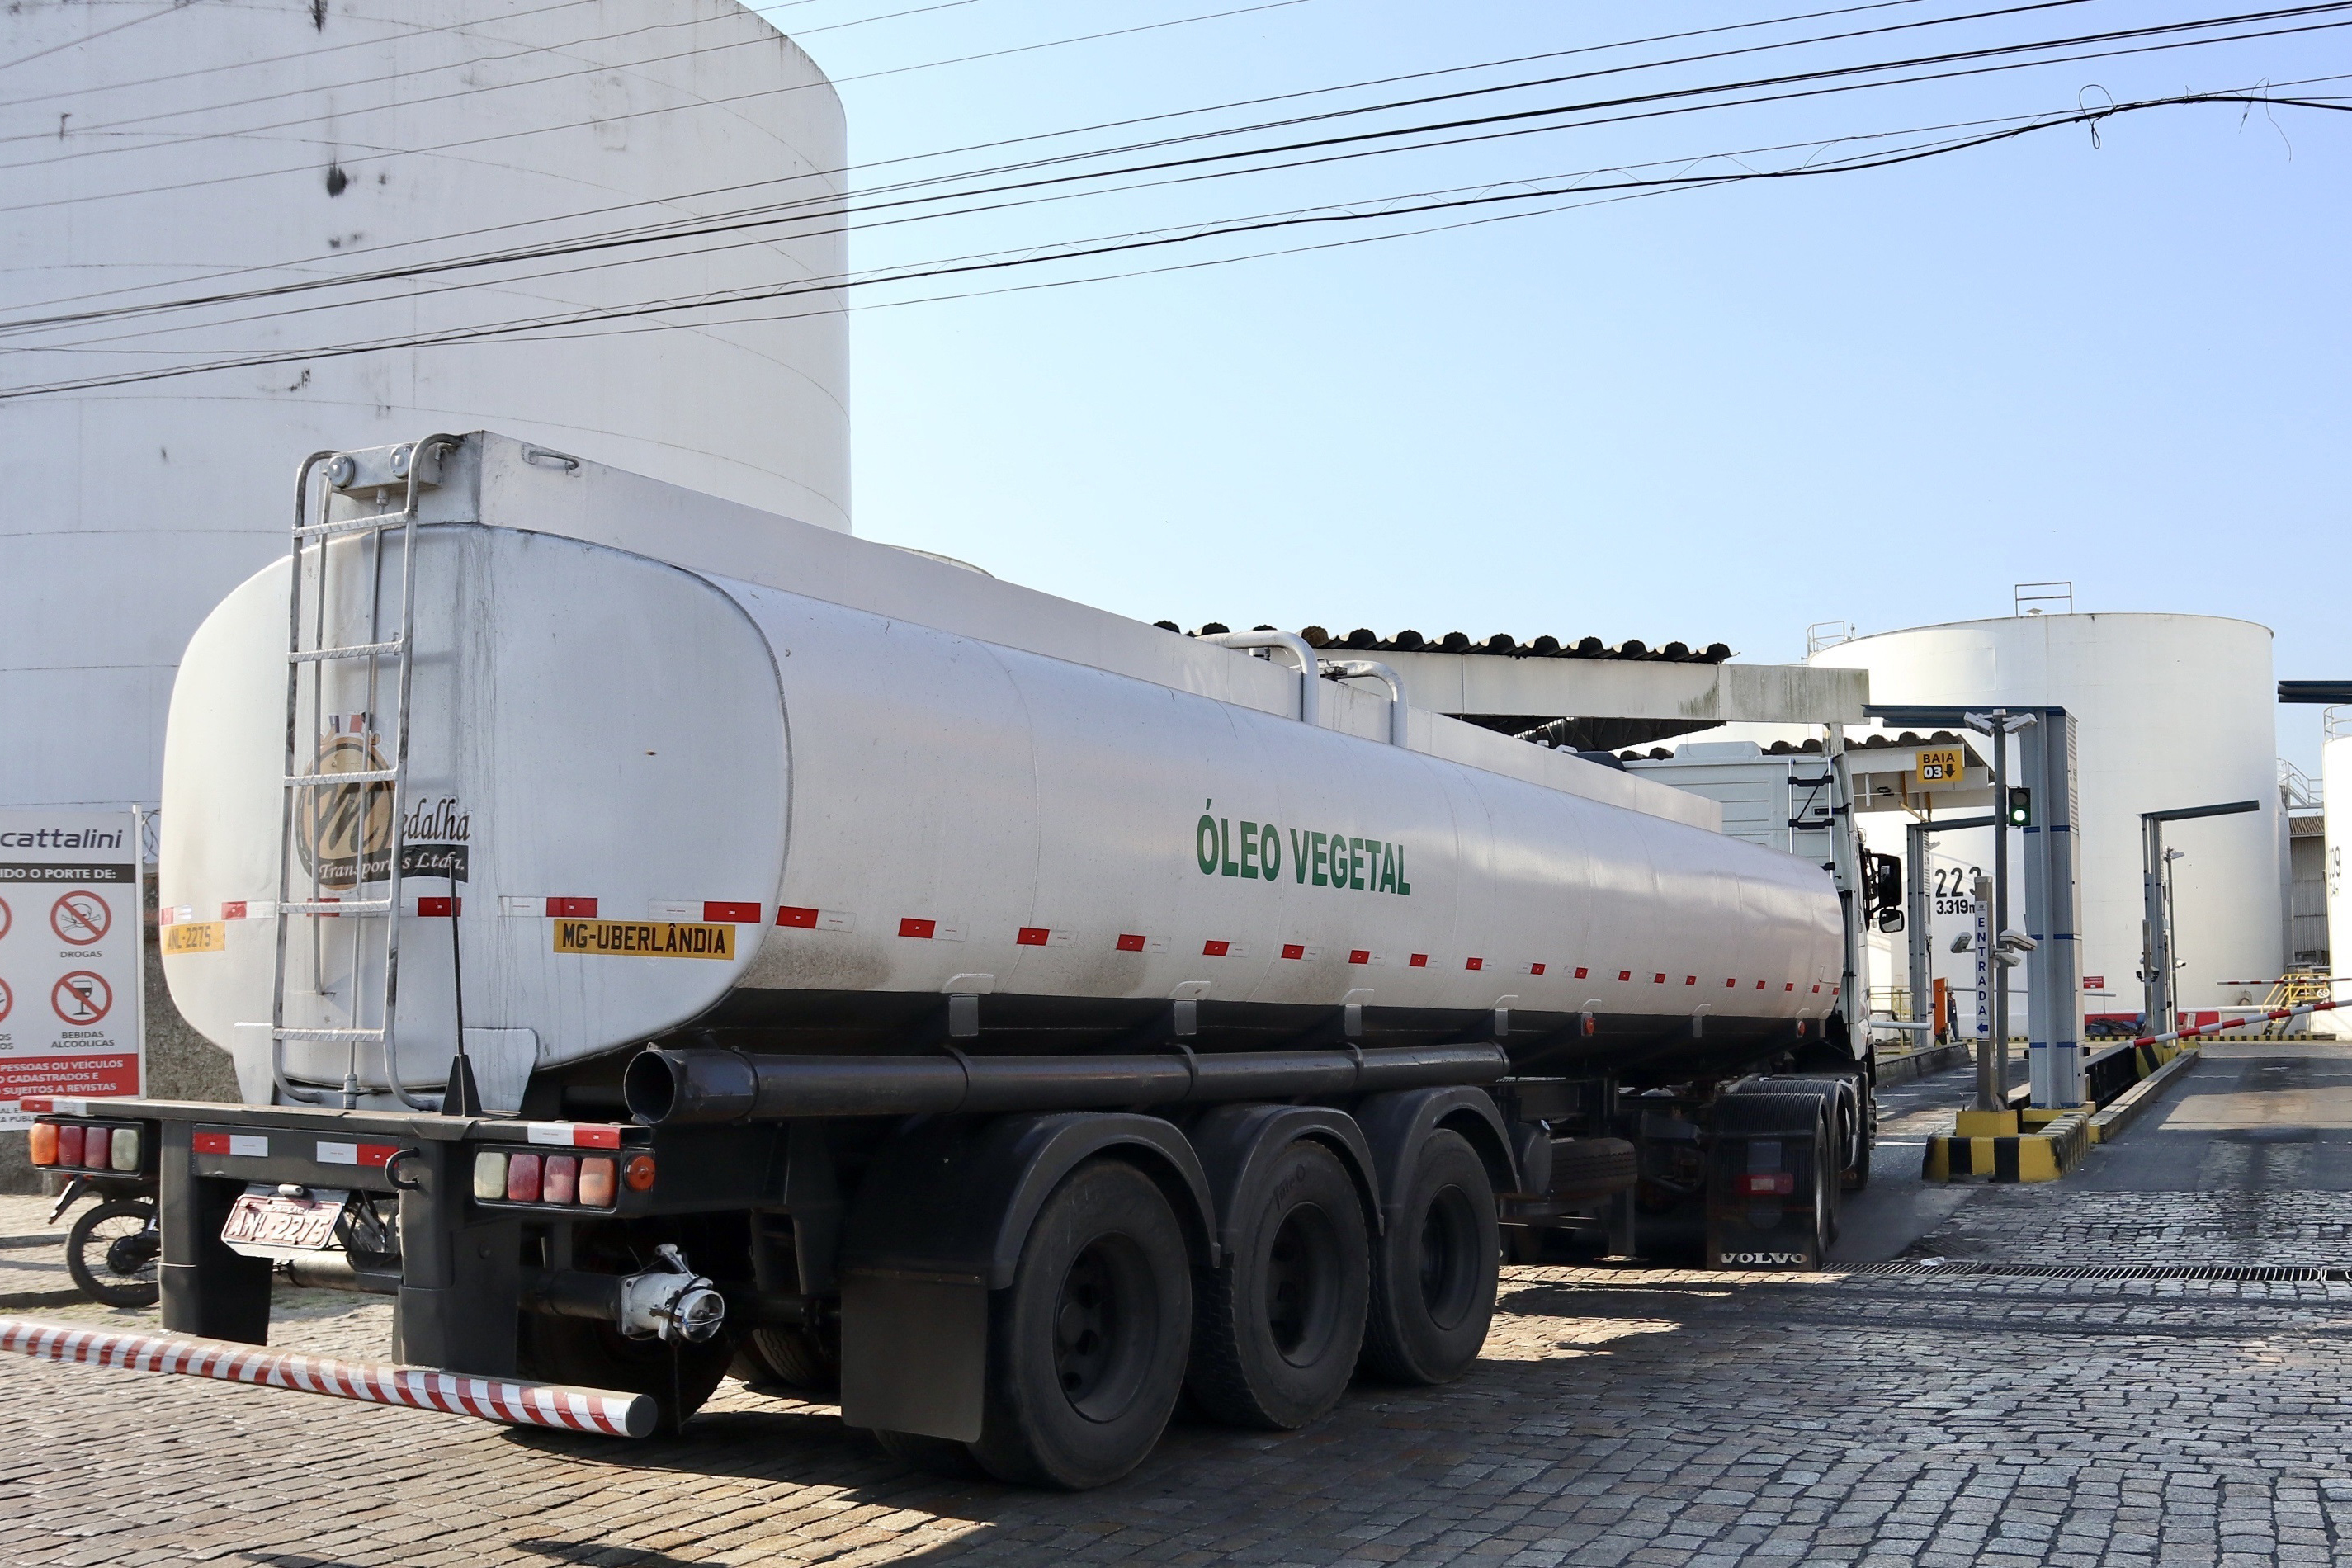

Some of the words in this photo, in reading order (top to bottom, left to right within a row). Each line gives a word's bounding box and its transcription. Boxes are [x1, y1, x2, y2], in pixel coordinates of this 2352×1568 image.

[1924, 753, 1955, 763] BAIA
[1924, 766, 1943, 778] 03
[0, 829, 123, 848] cattalini
[1197, 798, 1281, 882] ÓLEO
[1290, 828, 1410, 895] VEGETAL
[30, 869, 41, 879] O
[45, 869, 91, 879] PORTE
[93, 869, 116, 879] DE:
[319, 857, 411, 879] Tranports
[562, 923, 726, 954] MG-UBERLÂNDIA
[1977, 917, 1987, 1016] ENTRADA
[62, 1031, 104, 1039] BEBIDAS
[1, 1062, 49, 1072] PESSOAS
[51, 1061, 68, 1070] OU
[71, 1059, 123, 1069] VEÍCULOS
[7, 1073, 90, 1083] CADASTRADOS
[3, 1085, 54, 1096] SUJEITOS
[67, 1083, 116, 1092] REVISTAS
[1721, 1253, 1807, 1263] VOLVO
